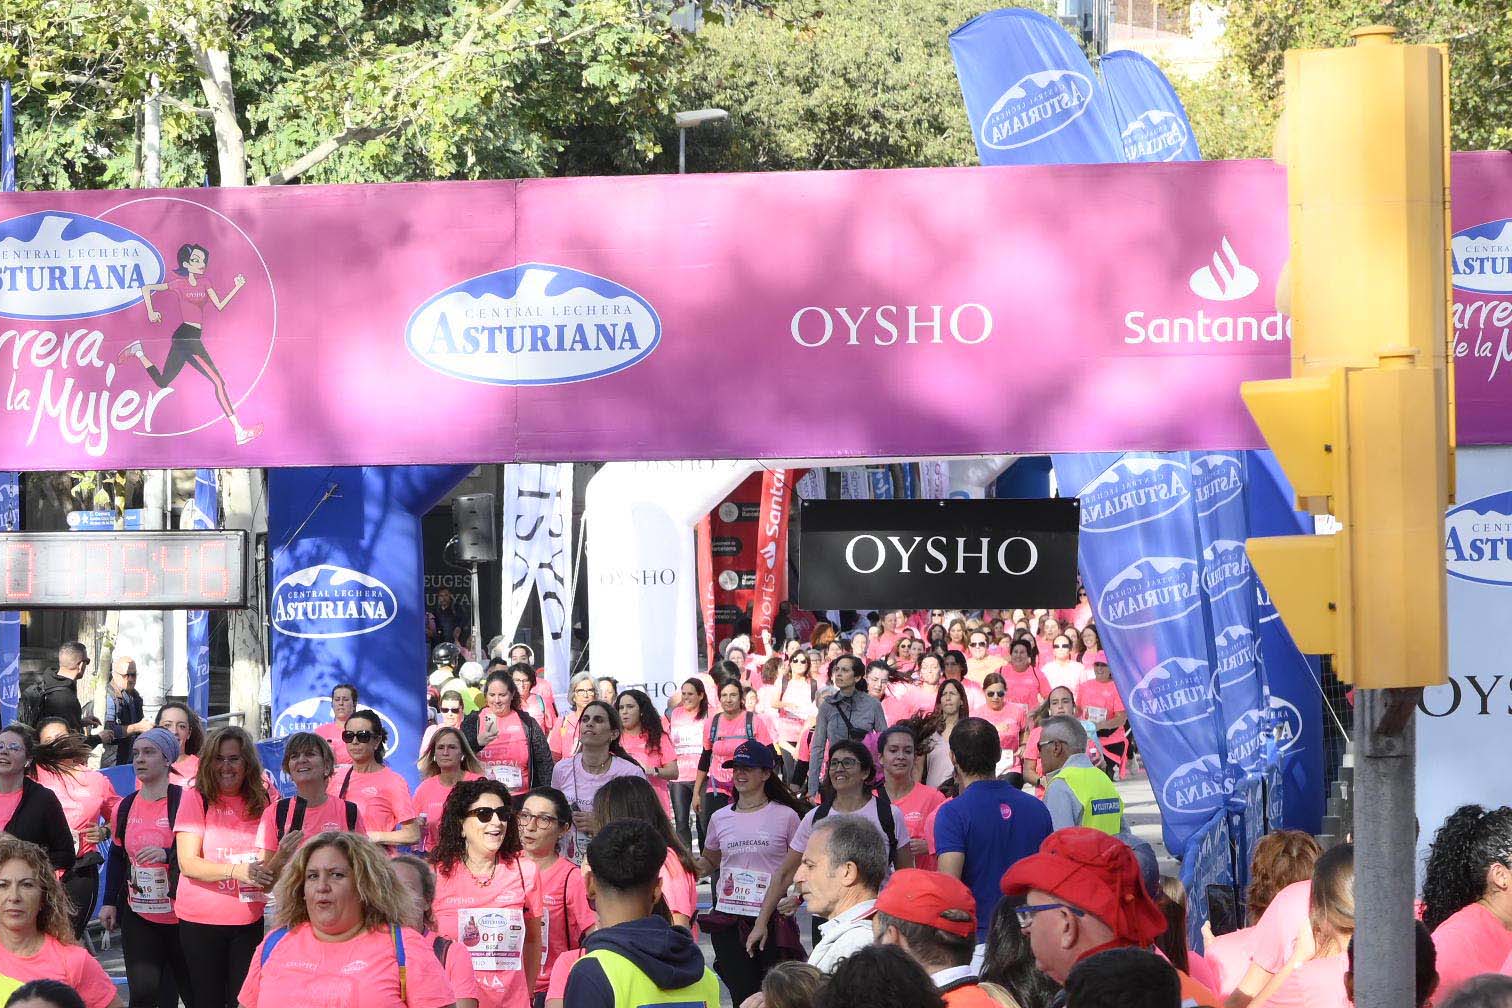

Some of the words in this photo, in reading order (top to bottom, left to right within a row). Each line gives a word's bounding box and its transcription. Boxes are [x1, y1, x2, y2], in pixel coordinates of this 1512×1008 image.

[68, 248, 140, 258] LECHERA
[464, 306, 544, 319] CENTRAL
[552, 304, 633, 316] LECHERA
[428, 311, 642, 354] ASTURIANA
[790, 303, 994, 348] OYSHO
[6, 370, 31, 411] la
[26, 362, 176, 457] Mujer
[844, 533, 1040, 576] OYSHO
[288, 590, 330, 598] CENTRAL
[335, 589, 383, 597] LECHERA
[274, 595, 387, 623] ASTURIANA
[727, 839, 770, 849] CUATRECASAS
[215, 847, 233, 859] TU
[481, 932, 504, 942] 016
